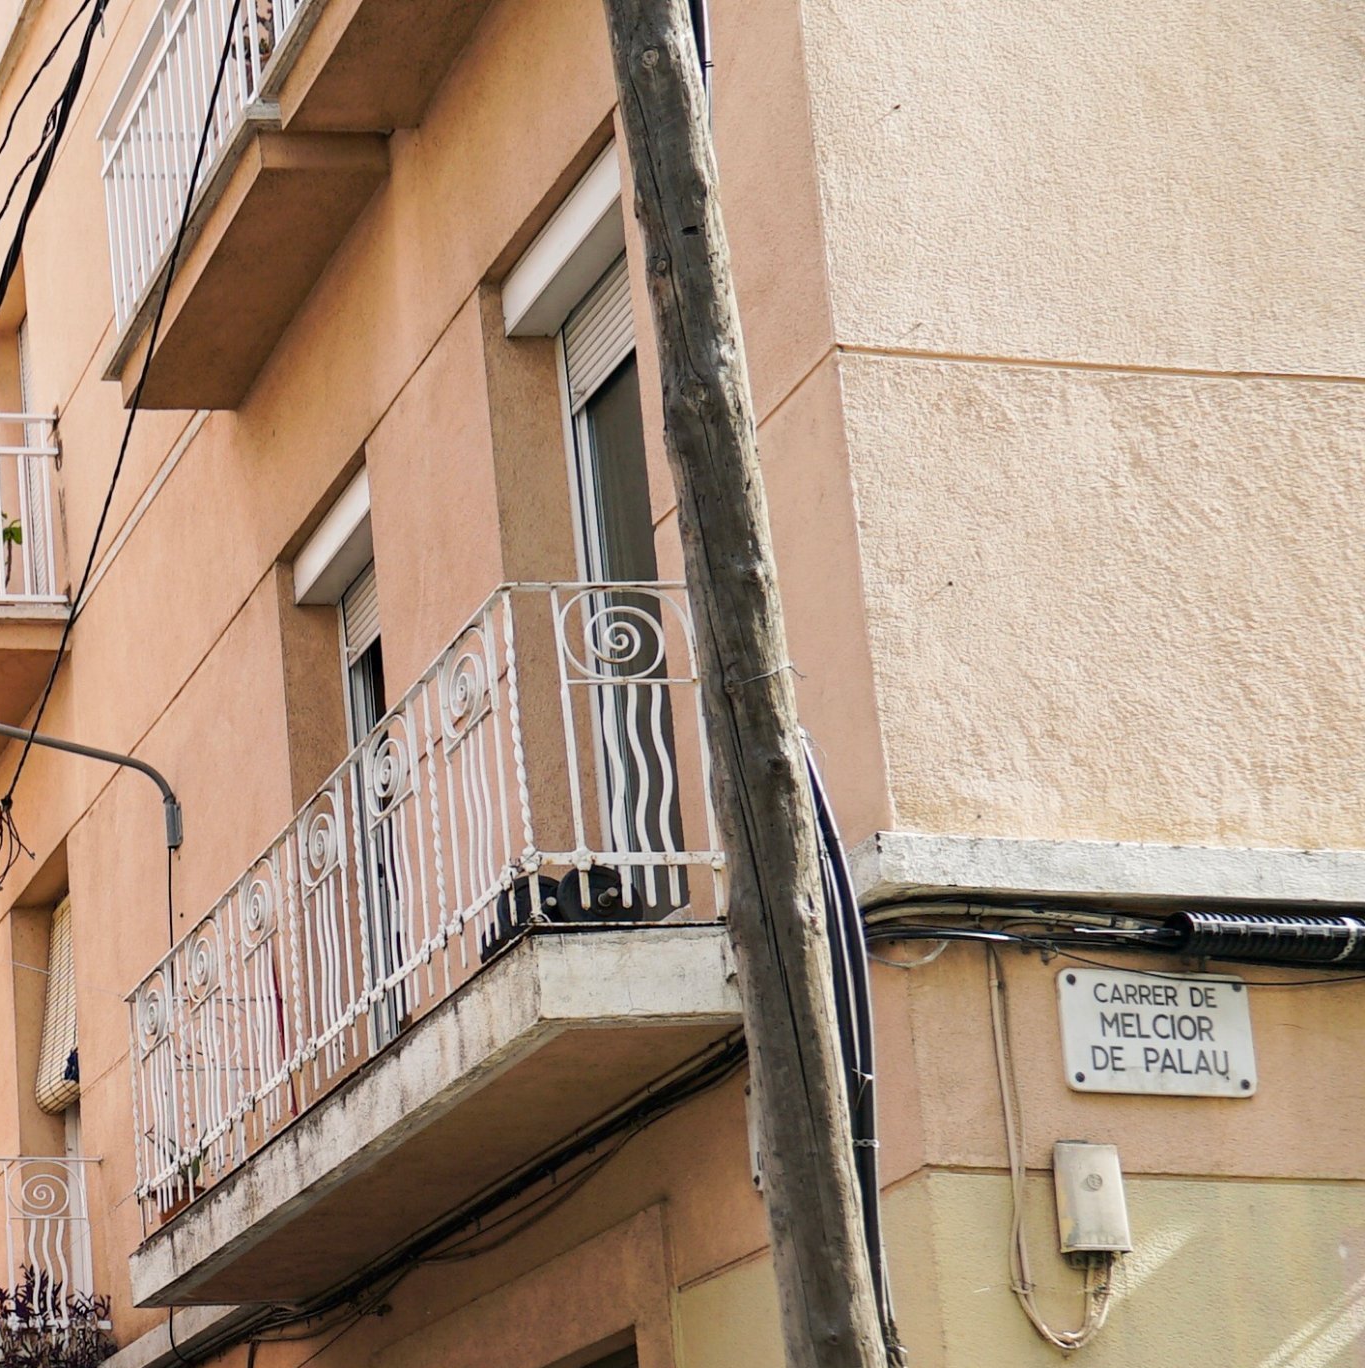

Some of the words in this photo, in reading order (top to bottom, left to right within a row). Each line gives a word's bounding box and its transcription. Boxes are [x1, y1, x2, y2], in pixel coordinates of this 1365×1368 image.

[1093, 982, 1179, 1007] CARRER
[1189, 987, 1218, 1008] DE
[1099, 1012, 1215, 1042] MELCIOR
[1090, 1045, 1126, 1072] DE
[1143, 1047, 1230, 1075] PALAU
